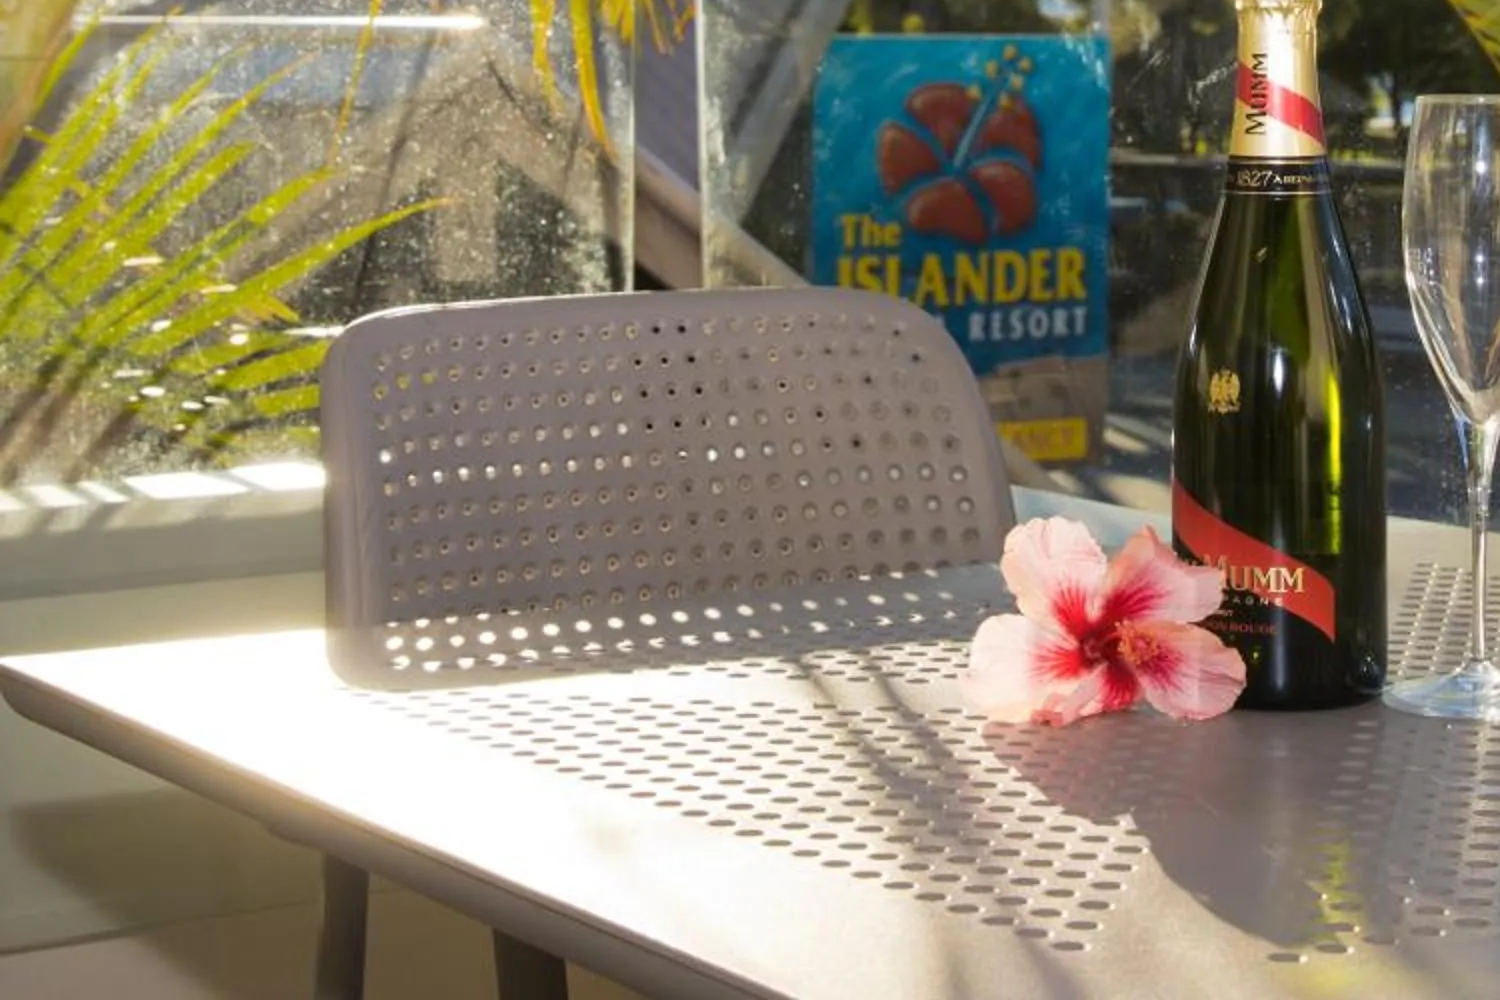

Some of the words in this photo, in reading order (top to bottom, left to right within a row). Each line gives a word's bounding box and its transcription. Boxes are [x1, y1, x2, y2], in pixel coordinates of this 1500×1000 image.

[1245, 52, 1268, 135] MUMM
[842, 216, 900, 247] The
[969, 307, 1087, 341] RESORT
